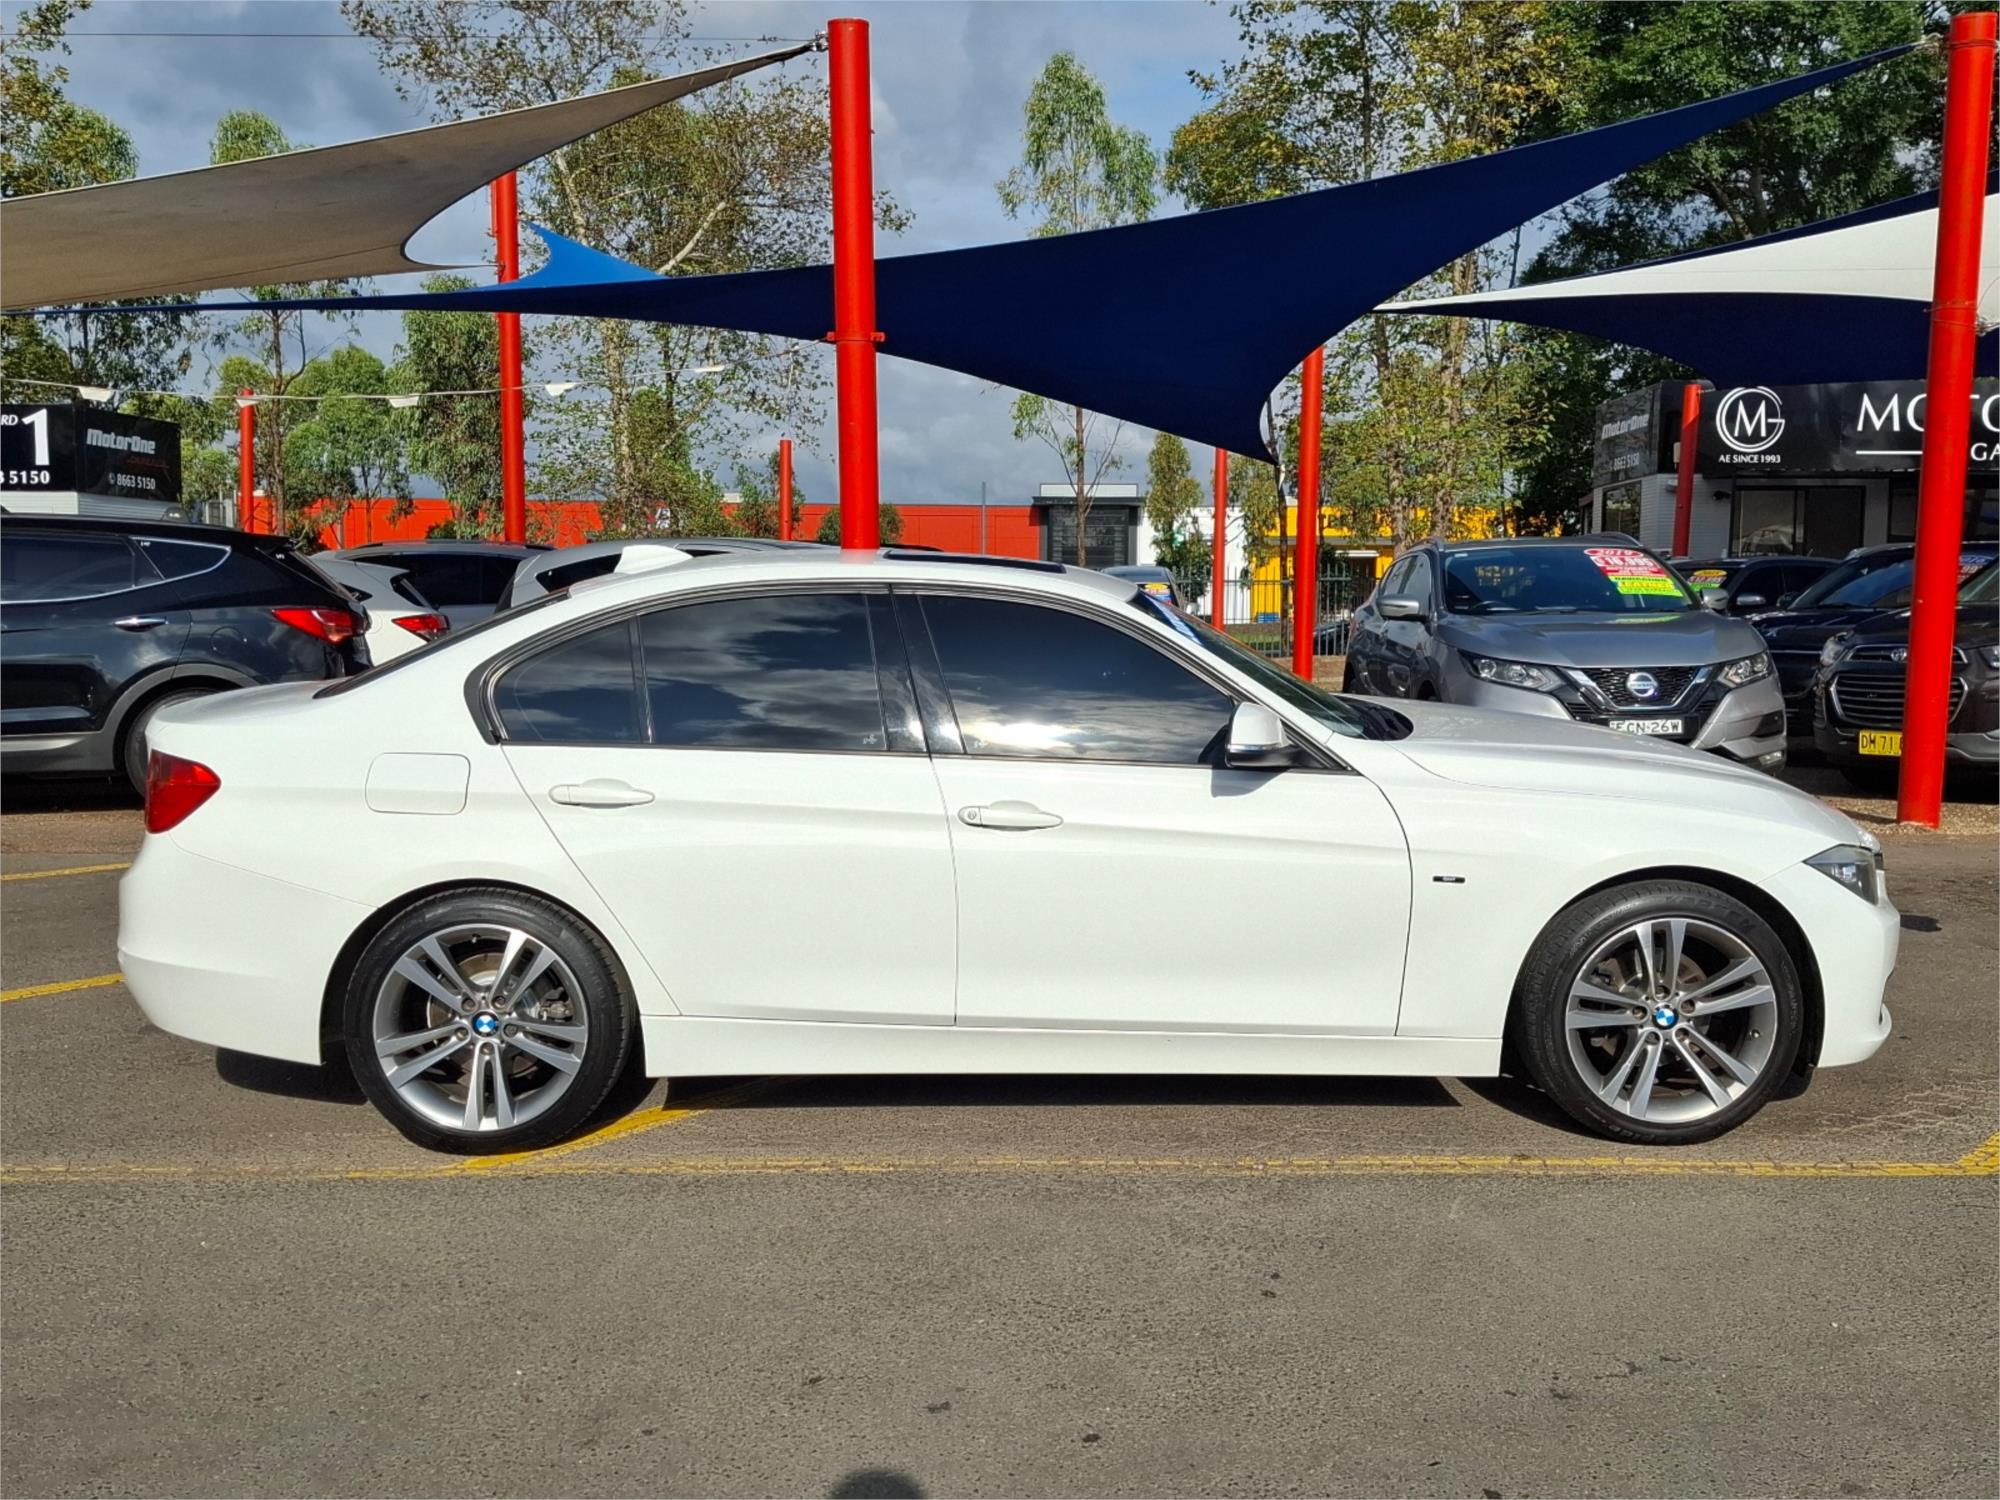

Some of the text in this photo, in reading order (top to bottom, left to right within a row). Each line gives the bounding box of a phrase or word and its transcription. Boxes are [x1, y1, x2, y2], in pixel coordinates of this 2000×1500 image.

[21, 407, 50, 466] 1
[86, 428, 156, 455] MotorOne
[1732, 454, 1759, 463] SINCE
[1760, 454, 1781, 463] 1993
[9, 470, 50, 484] 5150
[116, 473, 156, 490] 8663 5150
